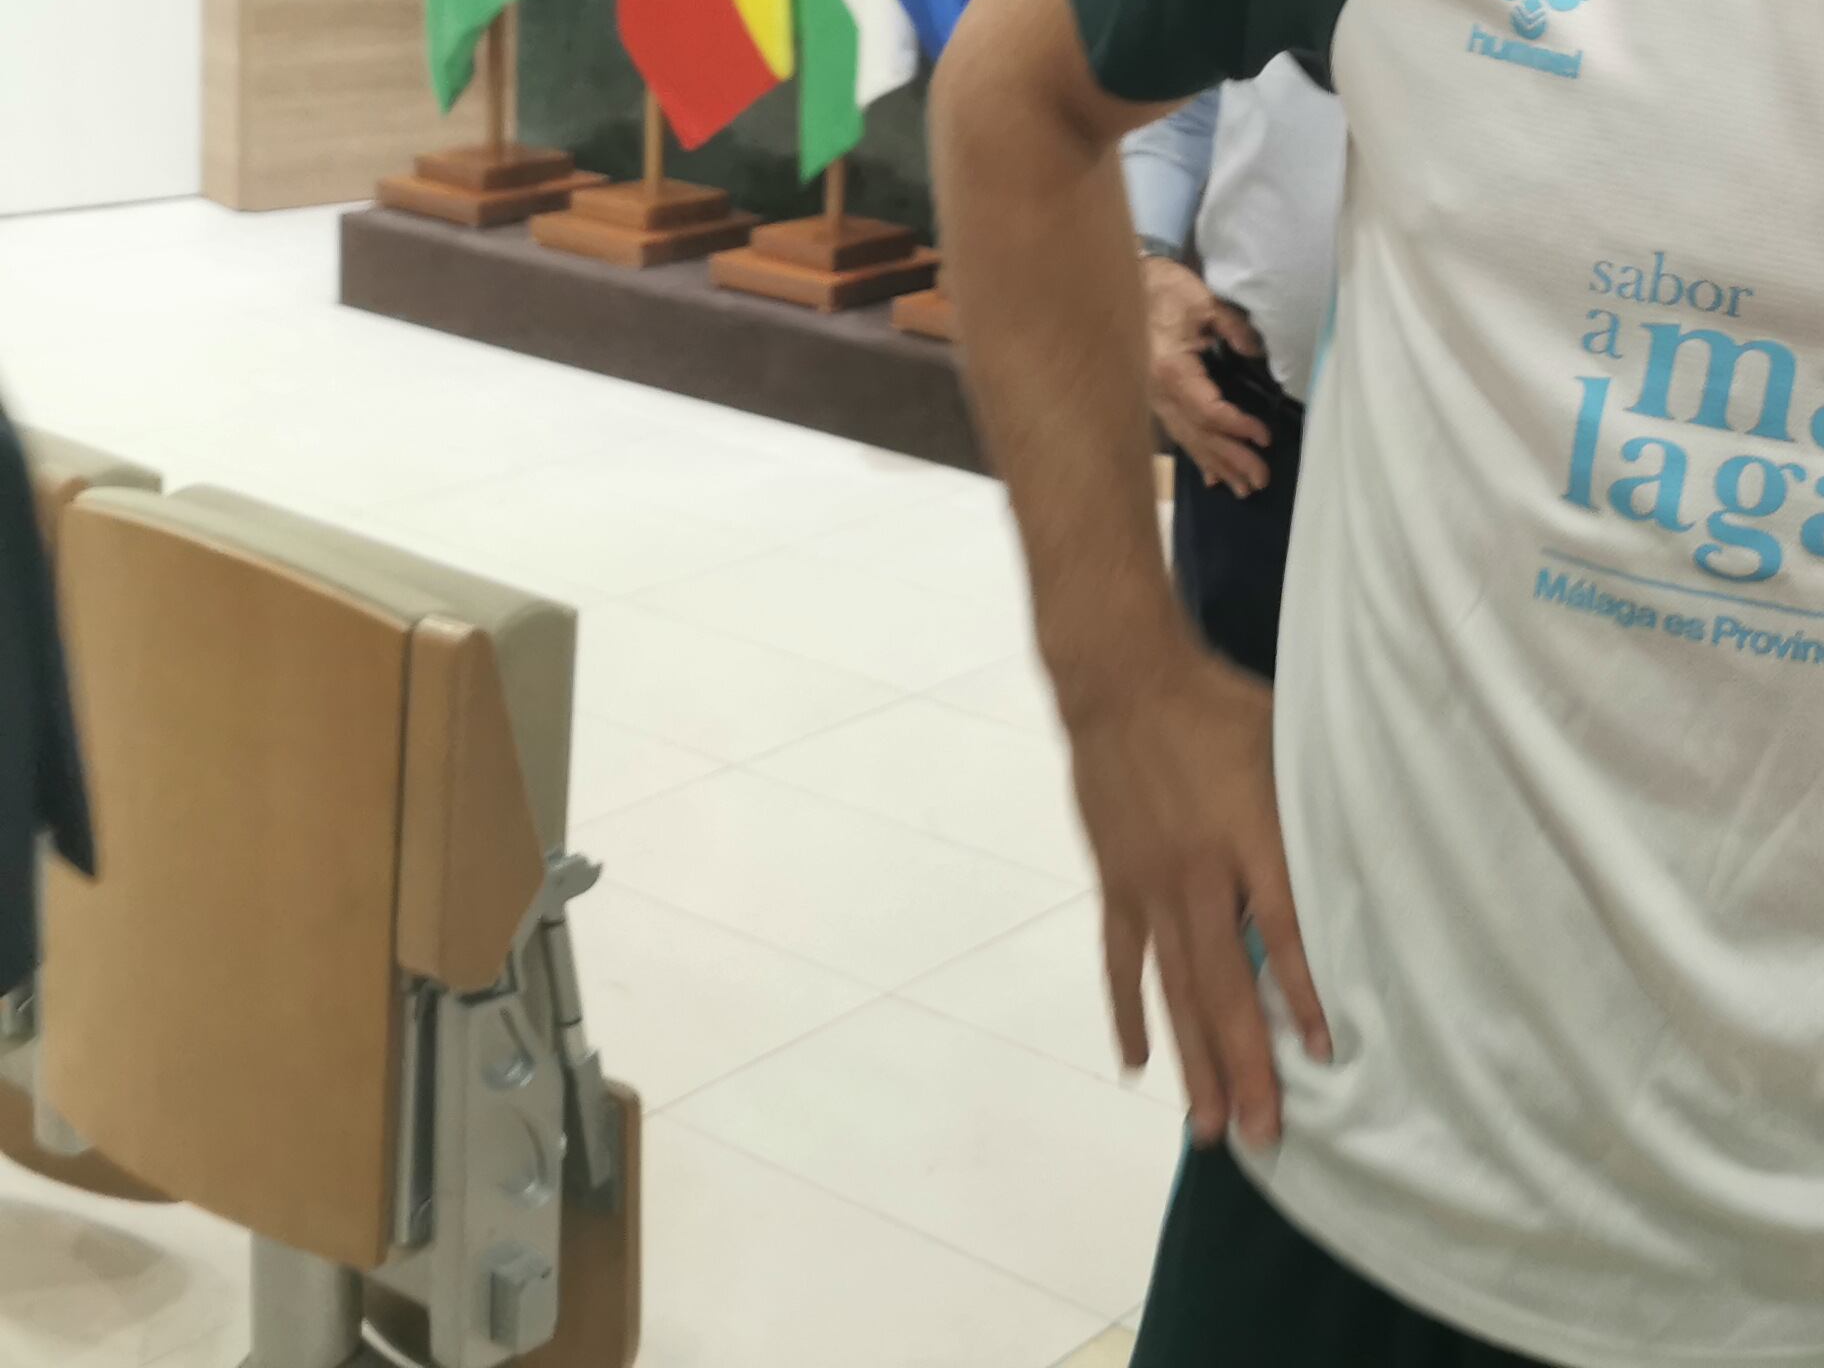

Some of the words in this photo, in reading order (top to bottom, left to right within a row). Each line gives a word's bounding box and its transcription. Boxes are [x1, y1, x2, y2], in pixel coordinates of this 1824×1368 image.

[1588, 251, 1754, 318] sabor
[1580, 308, 1624, 361] a
[1534, 567, 1658, 629] Málaga
[1663, 613, 1706, 642] es
